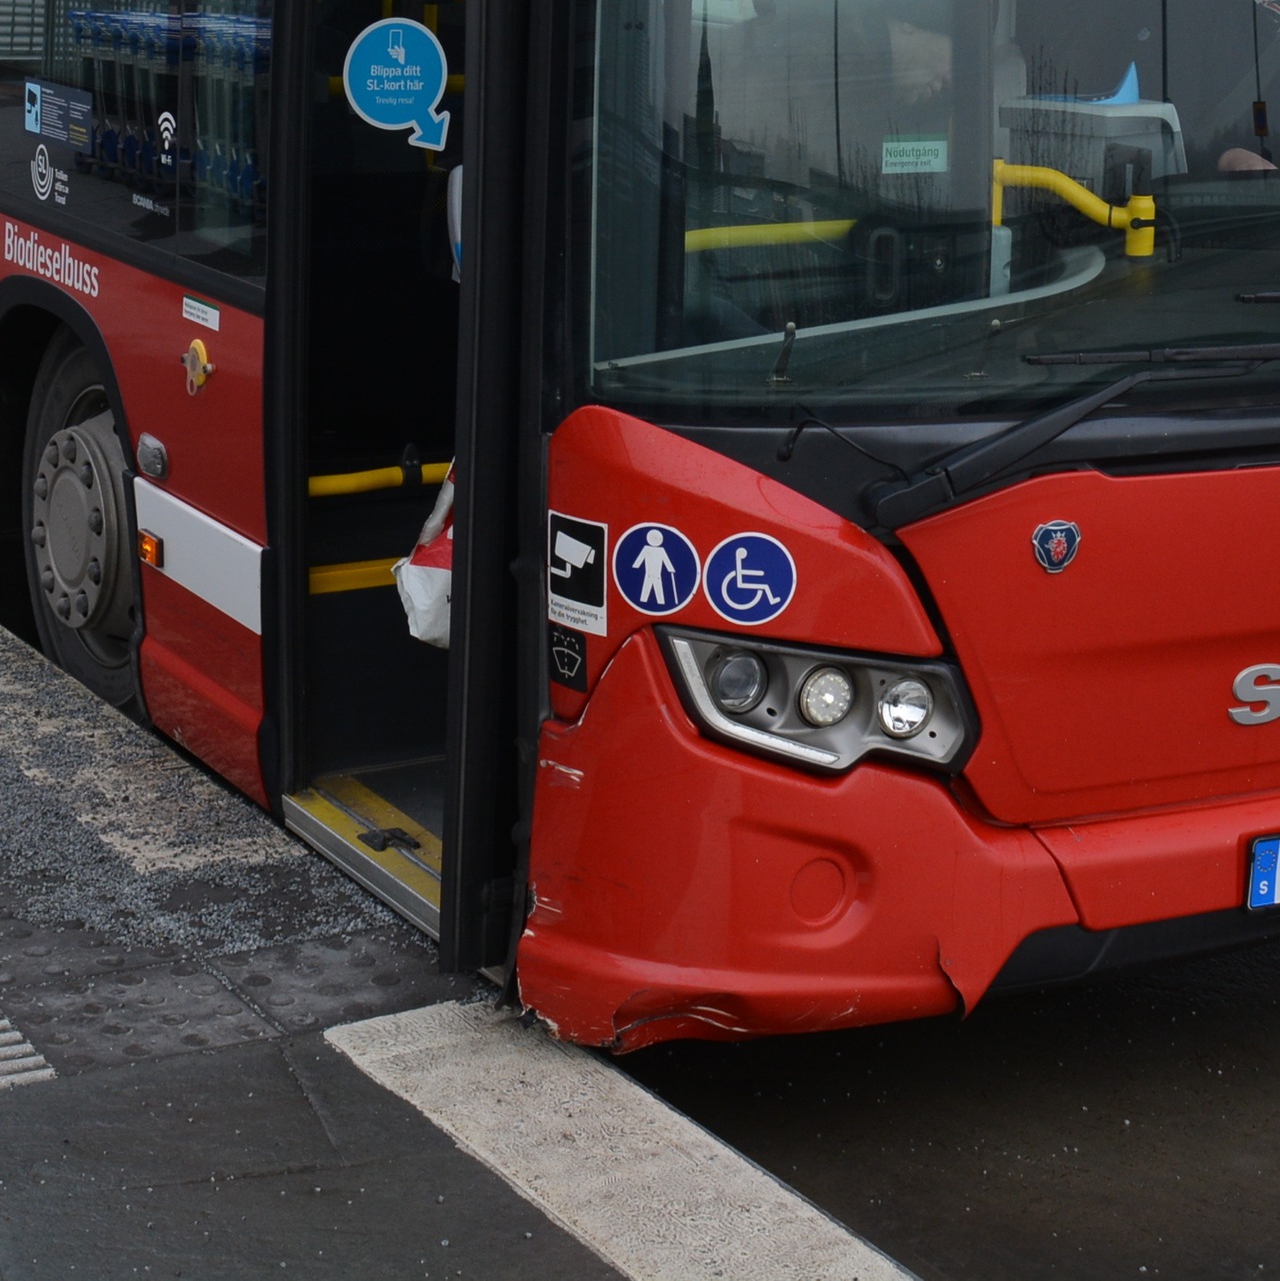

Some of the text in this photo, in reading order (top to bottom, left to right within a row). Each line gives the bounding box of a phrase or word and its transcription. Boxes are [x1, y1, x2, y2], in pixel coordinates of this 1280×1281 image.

[370, 64, 422, 78] Blippa ditt
[366, 79, 424, 90] SL-kort här
[885, 146, 940, 159] Nödutgång
[4, 221, 99, 298] Biodieselbuss
[1258, 880, 1269, 895] S
